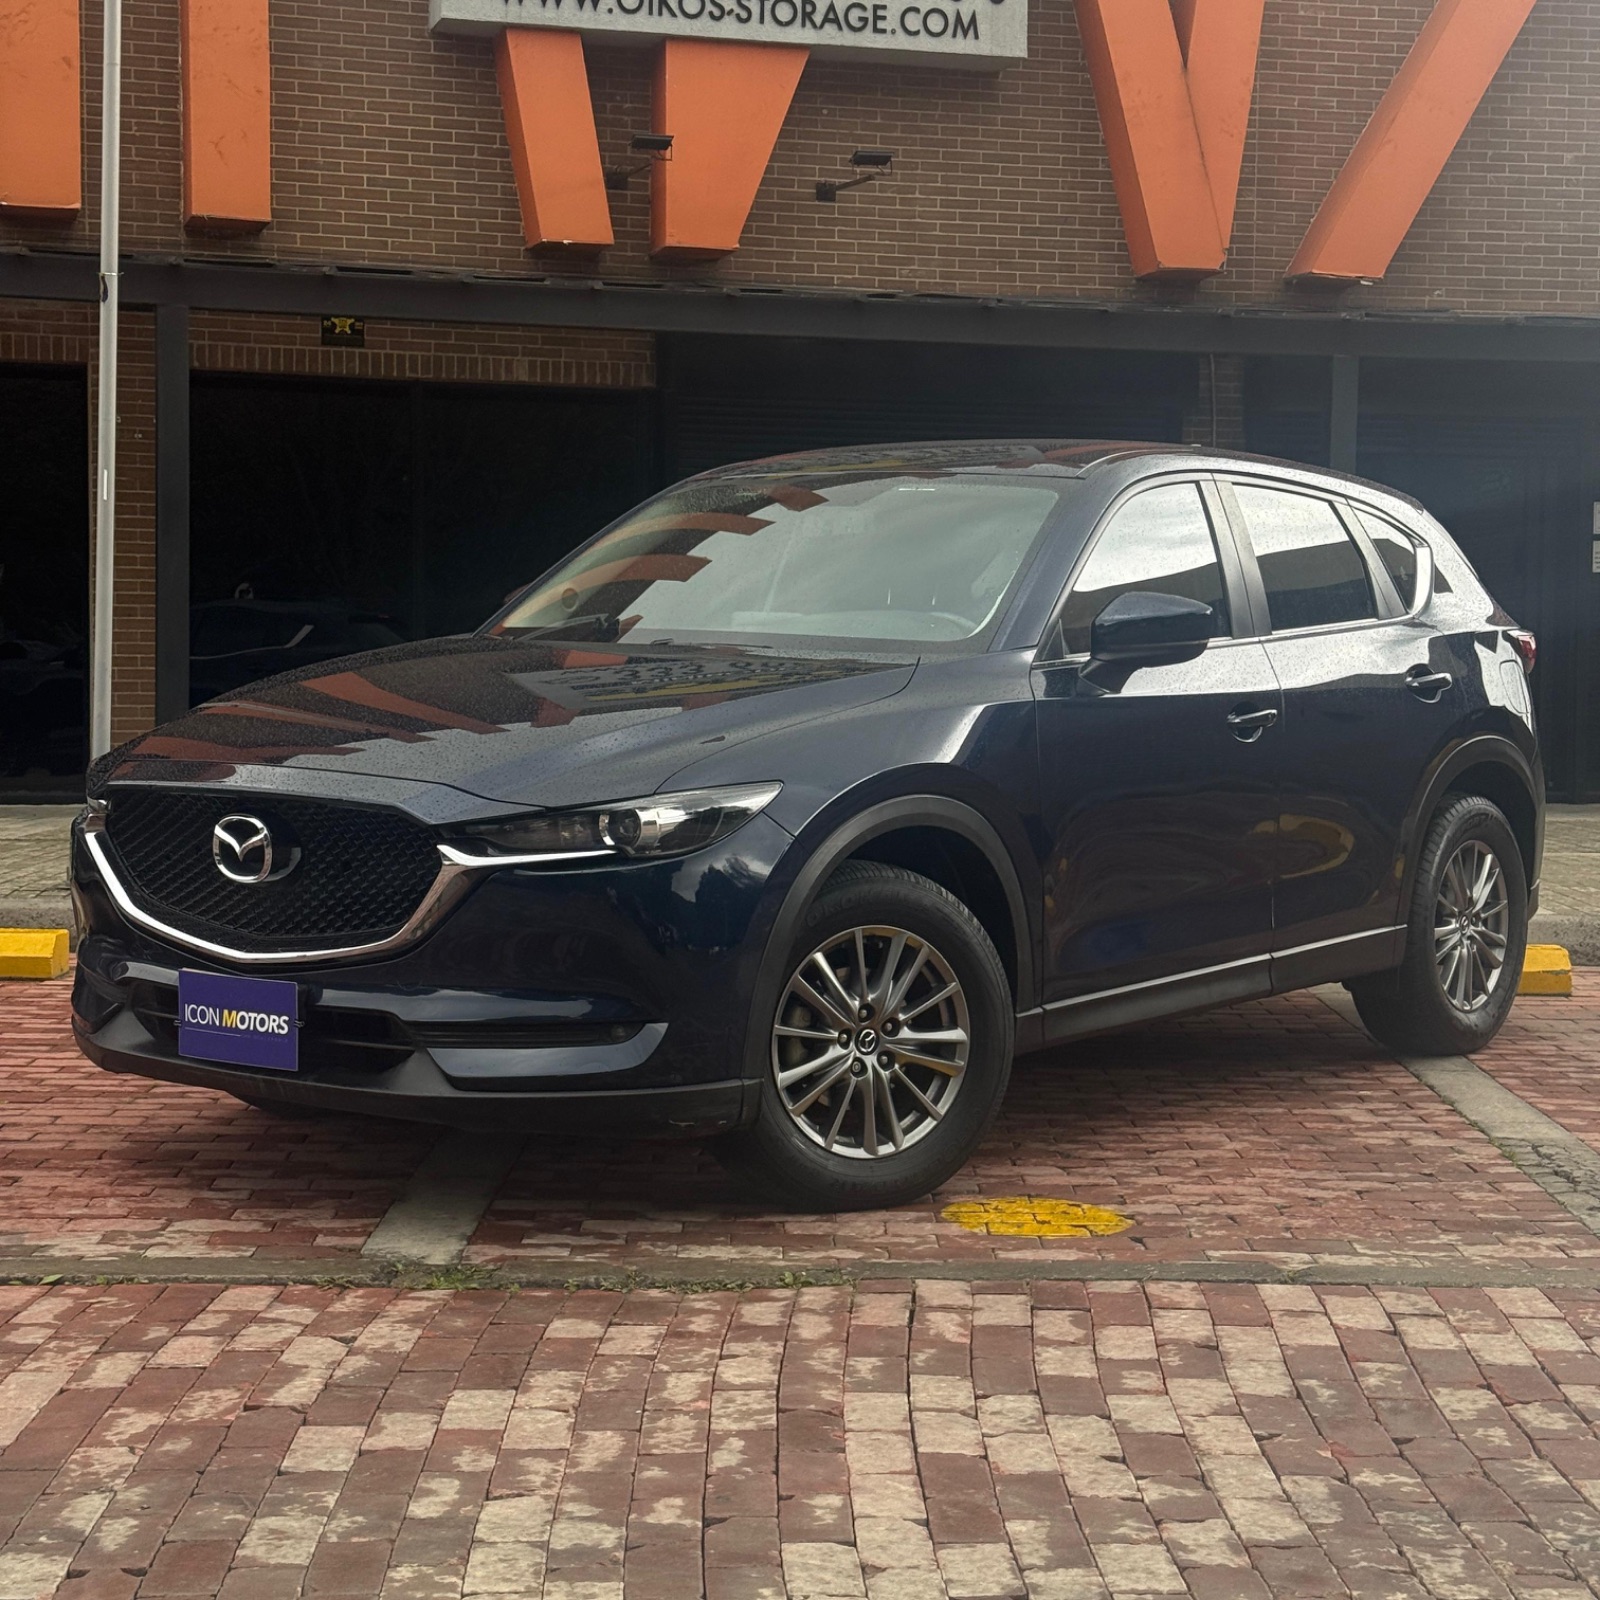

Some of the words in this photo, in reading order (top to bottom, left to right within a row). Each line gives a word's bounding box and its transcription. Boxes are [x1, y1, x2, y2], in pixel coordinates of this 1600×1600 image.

[503, 0, 980, 40] .OIKOS-STORAGE.COM
[184, 1003, 220, 1027] ICON
[222, 1009, 290, 1035] MOTORS
